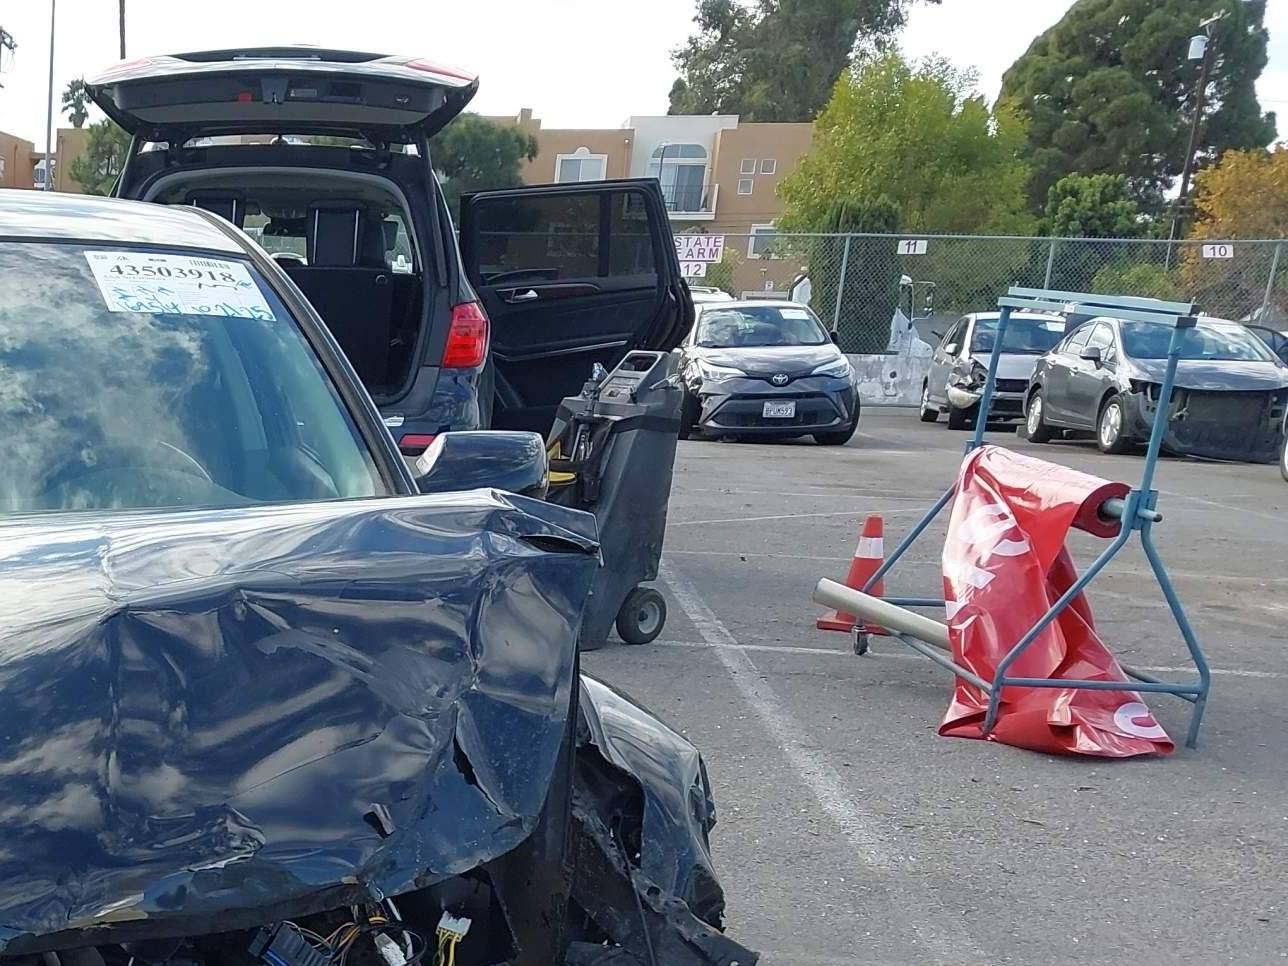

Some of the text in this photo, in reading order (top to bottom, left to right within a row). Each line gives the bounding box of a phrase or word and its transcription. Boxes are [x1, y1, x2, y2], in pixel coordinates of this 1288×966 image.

[674, 236, 722, 248] STATE
[905, 240, 918, 254] 11
[1209, 245, 1228, 257] 10
[110, 263, 236, 283] 43503918
[684, 263, 702, 276] 12
